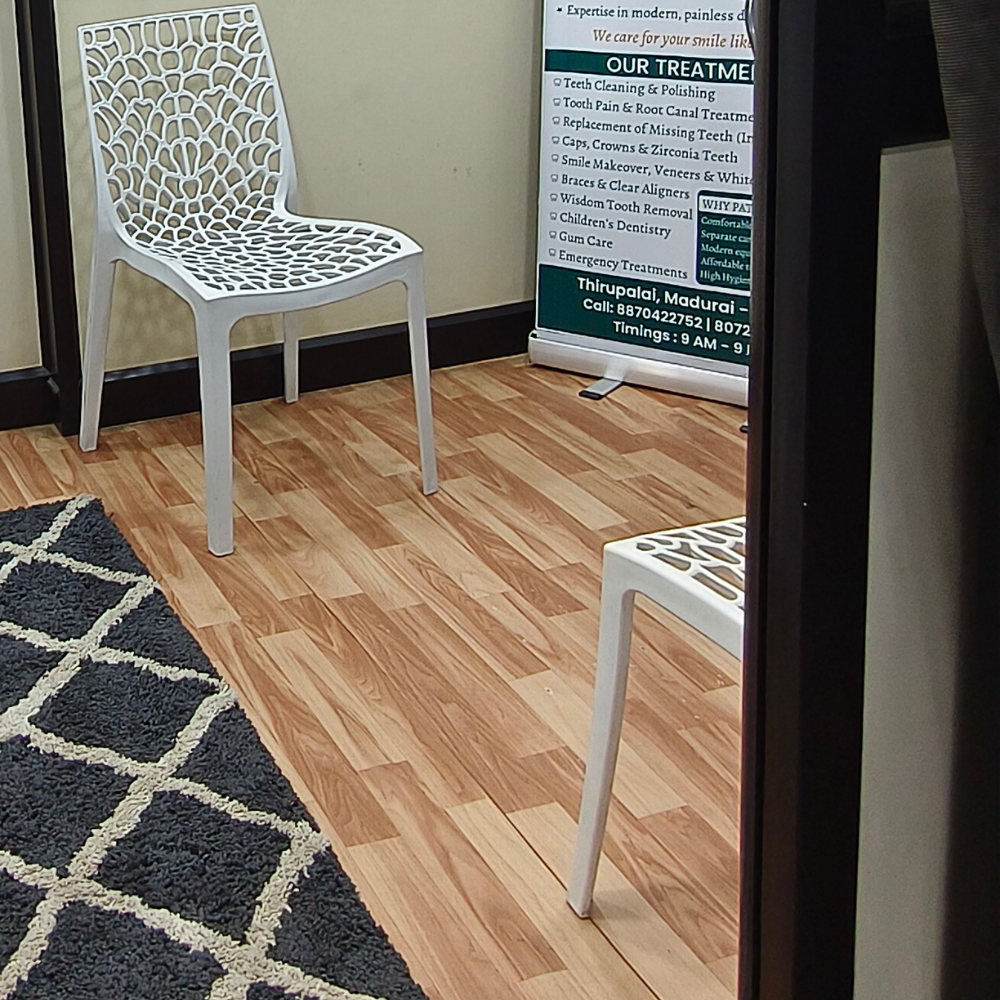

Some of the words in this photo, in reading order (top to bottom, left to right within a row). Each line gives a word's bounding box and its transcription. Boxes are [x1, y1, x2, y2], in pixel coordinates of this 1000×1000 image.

[567, 4, 615, 19] Expertise
[617, 6, 628, 17] in
[632, 6, 681, 21] modern,
[684, 8, 733, 22] painless
[593, 29, 611, 42] We
[614, 33, 638, 44] care
[640, 31, 660, 47] for
[660, 35, 690, 49] your
[692, 34, 726, 48] smile
[606, 56, 649, 75] OUR
[655, 58, 754, 81] TREATME
[563, 77, 592, 90] Teeth
[594, 80, 645, 97] Cleaning
[648, 83, 658, 95] &
[661, 85, 716, 102] Polishing
[563, 97, 593, 110] Tooth
[595, 100, 619, 113] Pain
[622, 102, 633, 113] &
[636, 103, 663, 115] Root
[666, 105, 699, 119] Canal
[563, 116, 632, 134] Replacement
[634, 122, 649, 135] of
[649, 124, 695, 142] Missing
[697, 128, 733, 143] Teeth
[562, 136, 590, 151] Caps,
[592, 139, 636, 154] Crowns
[638, 143, 649, 154] &
[651, 145, 700, 160] Zirconia
[702, 150, 738, 164] Teeth
[561, 154, 591, 169] Smile
[592, 159, 651, 176] Makeover,
[654, 165, 701, 181] Veneers
[703, 171, 715, 182] &
[561, 174, 595, 188] Braces
[597, 178, 608, 189] &
[609, 180, 640, 194] Clear
[642, 183, 690, 200] Aligners
[560, 192, 605, 209] Wisdom
[606, 199, 640, 214] Tooth
[643, 204, 693, 220] Removal
[702, 199, 730, 211] WHY
[560, 212, 614, 229] Children's
[617, 220, 671, 239] Dentistry
[700, 229, 737, 241] Separate
[559, 231, 585, 245] Gum
[587, 235, 613, 248] Care
[700, 243, 733, 255] Modern
[558, 250, 619, 271] Emergency
[620, 259, 688, 279] Treatments
[700, 257, 744, 270] Affordable
[700, 270, 720, 282] High
[576, 276, 661, 304] Thirupalai,
[665, 291, 735, 315] Madurai
[583, 299, 614, 314] Call:
[617, 303, 703, 330] 8870422752
[714, 319, 751, 337] 8072
[613, 320, 671, 343] Timings
[681, 333, 690, 345] 9
[693, 335, 717, 350] AM
[733, 341, 743, 355] 9
